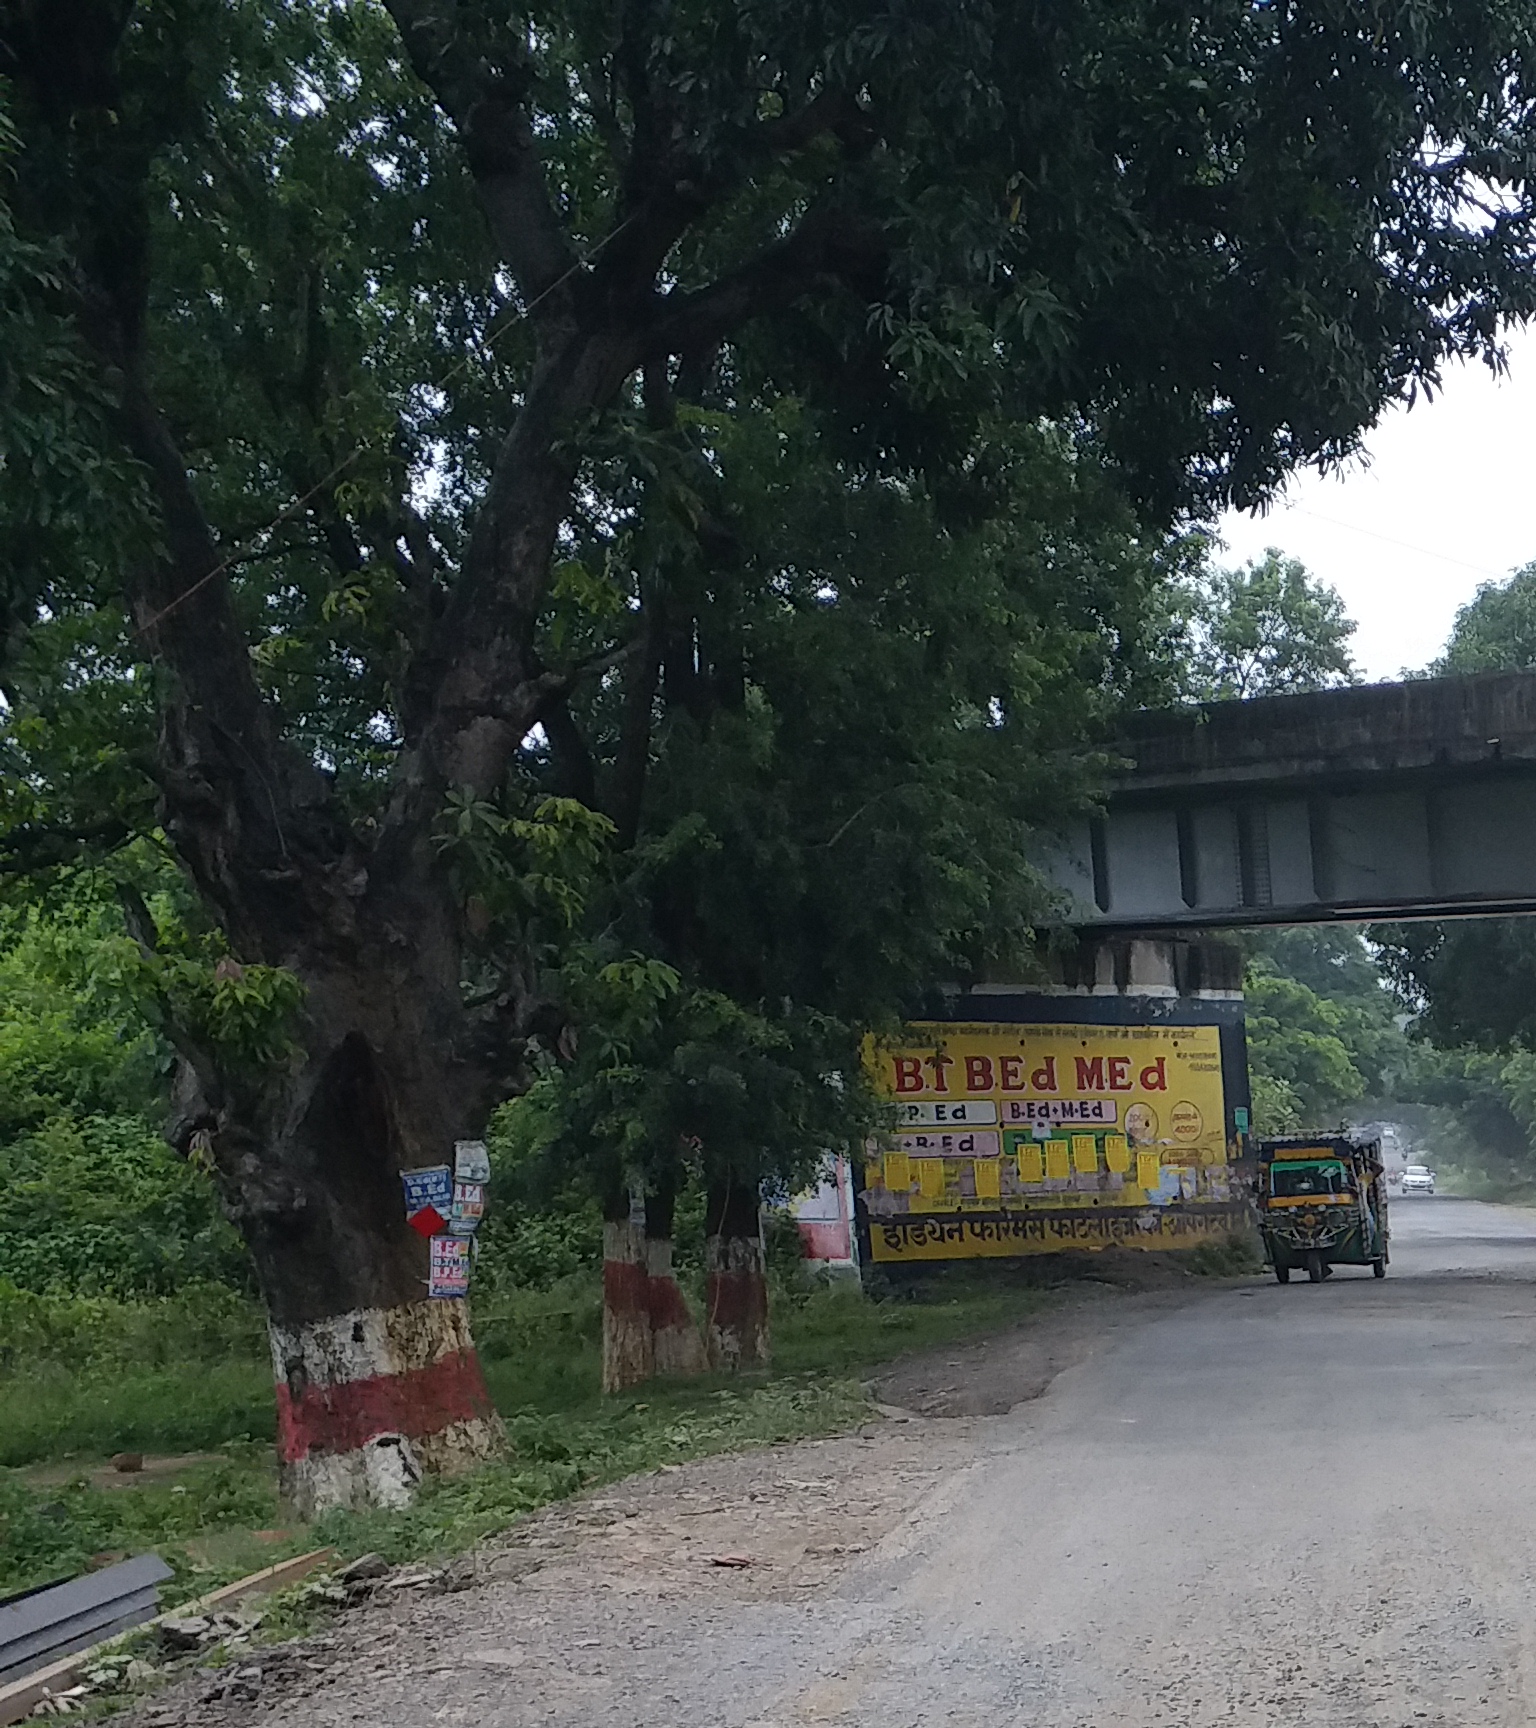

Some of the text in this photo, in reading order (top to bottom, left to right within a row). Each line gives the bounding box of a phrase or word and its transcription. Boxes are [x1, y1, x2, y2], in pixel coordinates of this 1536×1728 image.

[410, 1182, 447, 1198] B.Ed
[454, 1183, 481, 1203] B.Ed
[433, 1240, 460, 1258] B.Ed
